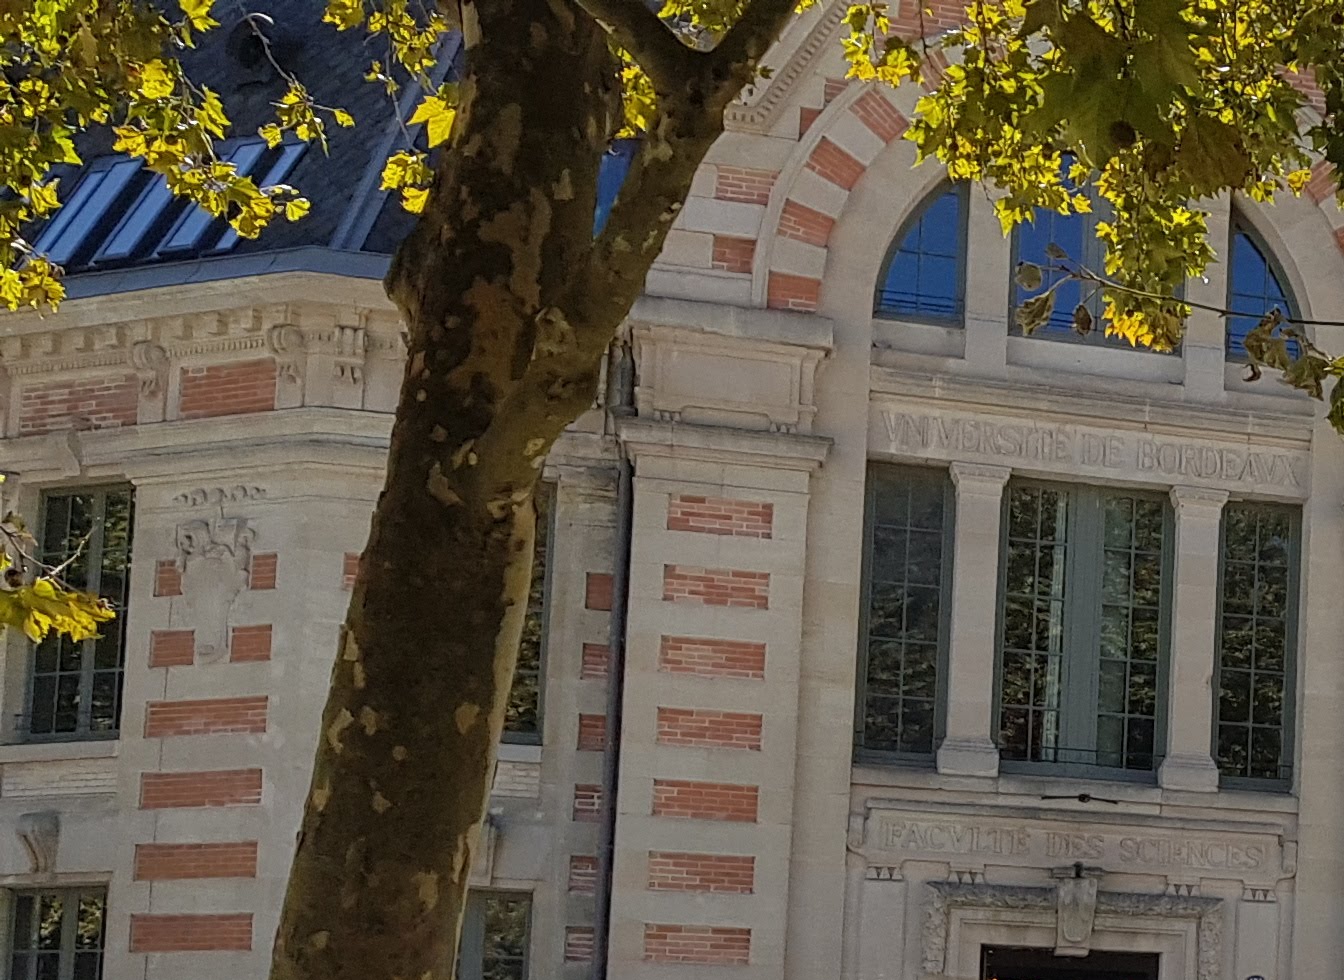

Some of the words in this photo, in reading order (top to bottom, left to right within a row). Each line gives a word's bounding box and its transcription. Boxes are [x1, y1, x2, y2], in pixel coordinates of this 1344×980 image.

[1081, 433, 1126, 468] DE
[1046, 831, 1105, 858] DES
[1119, 837, 1264, 868] SCIENCES
